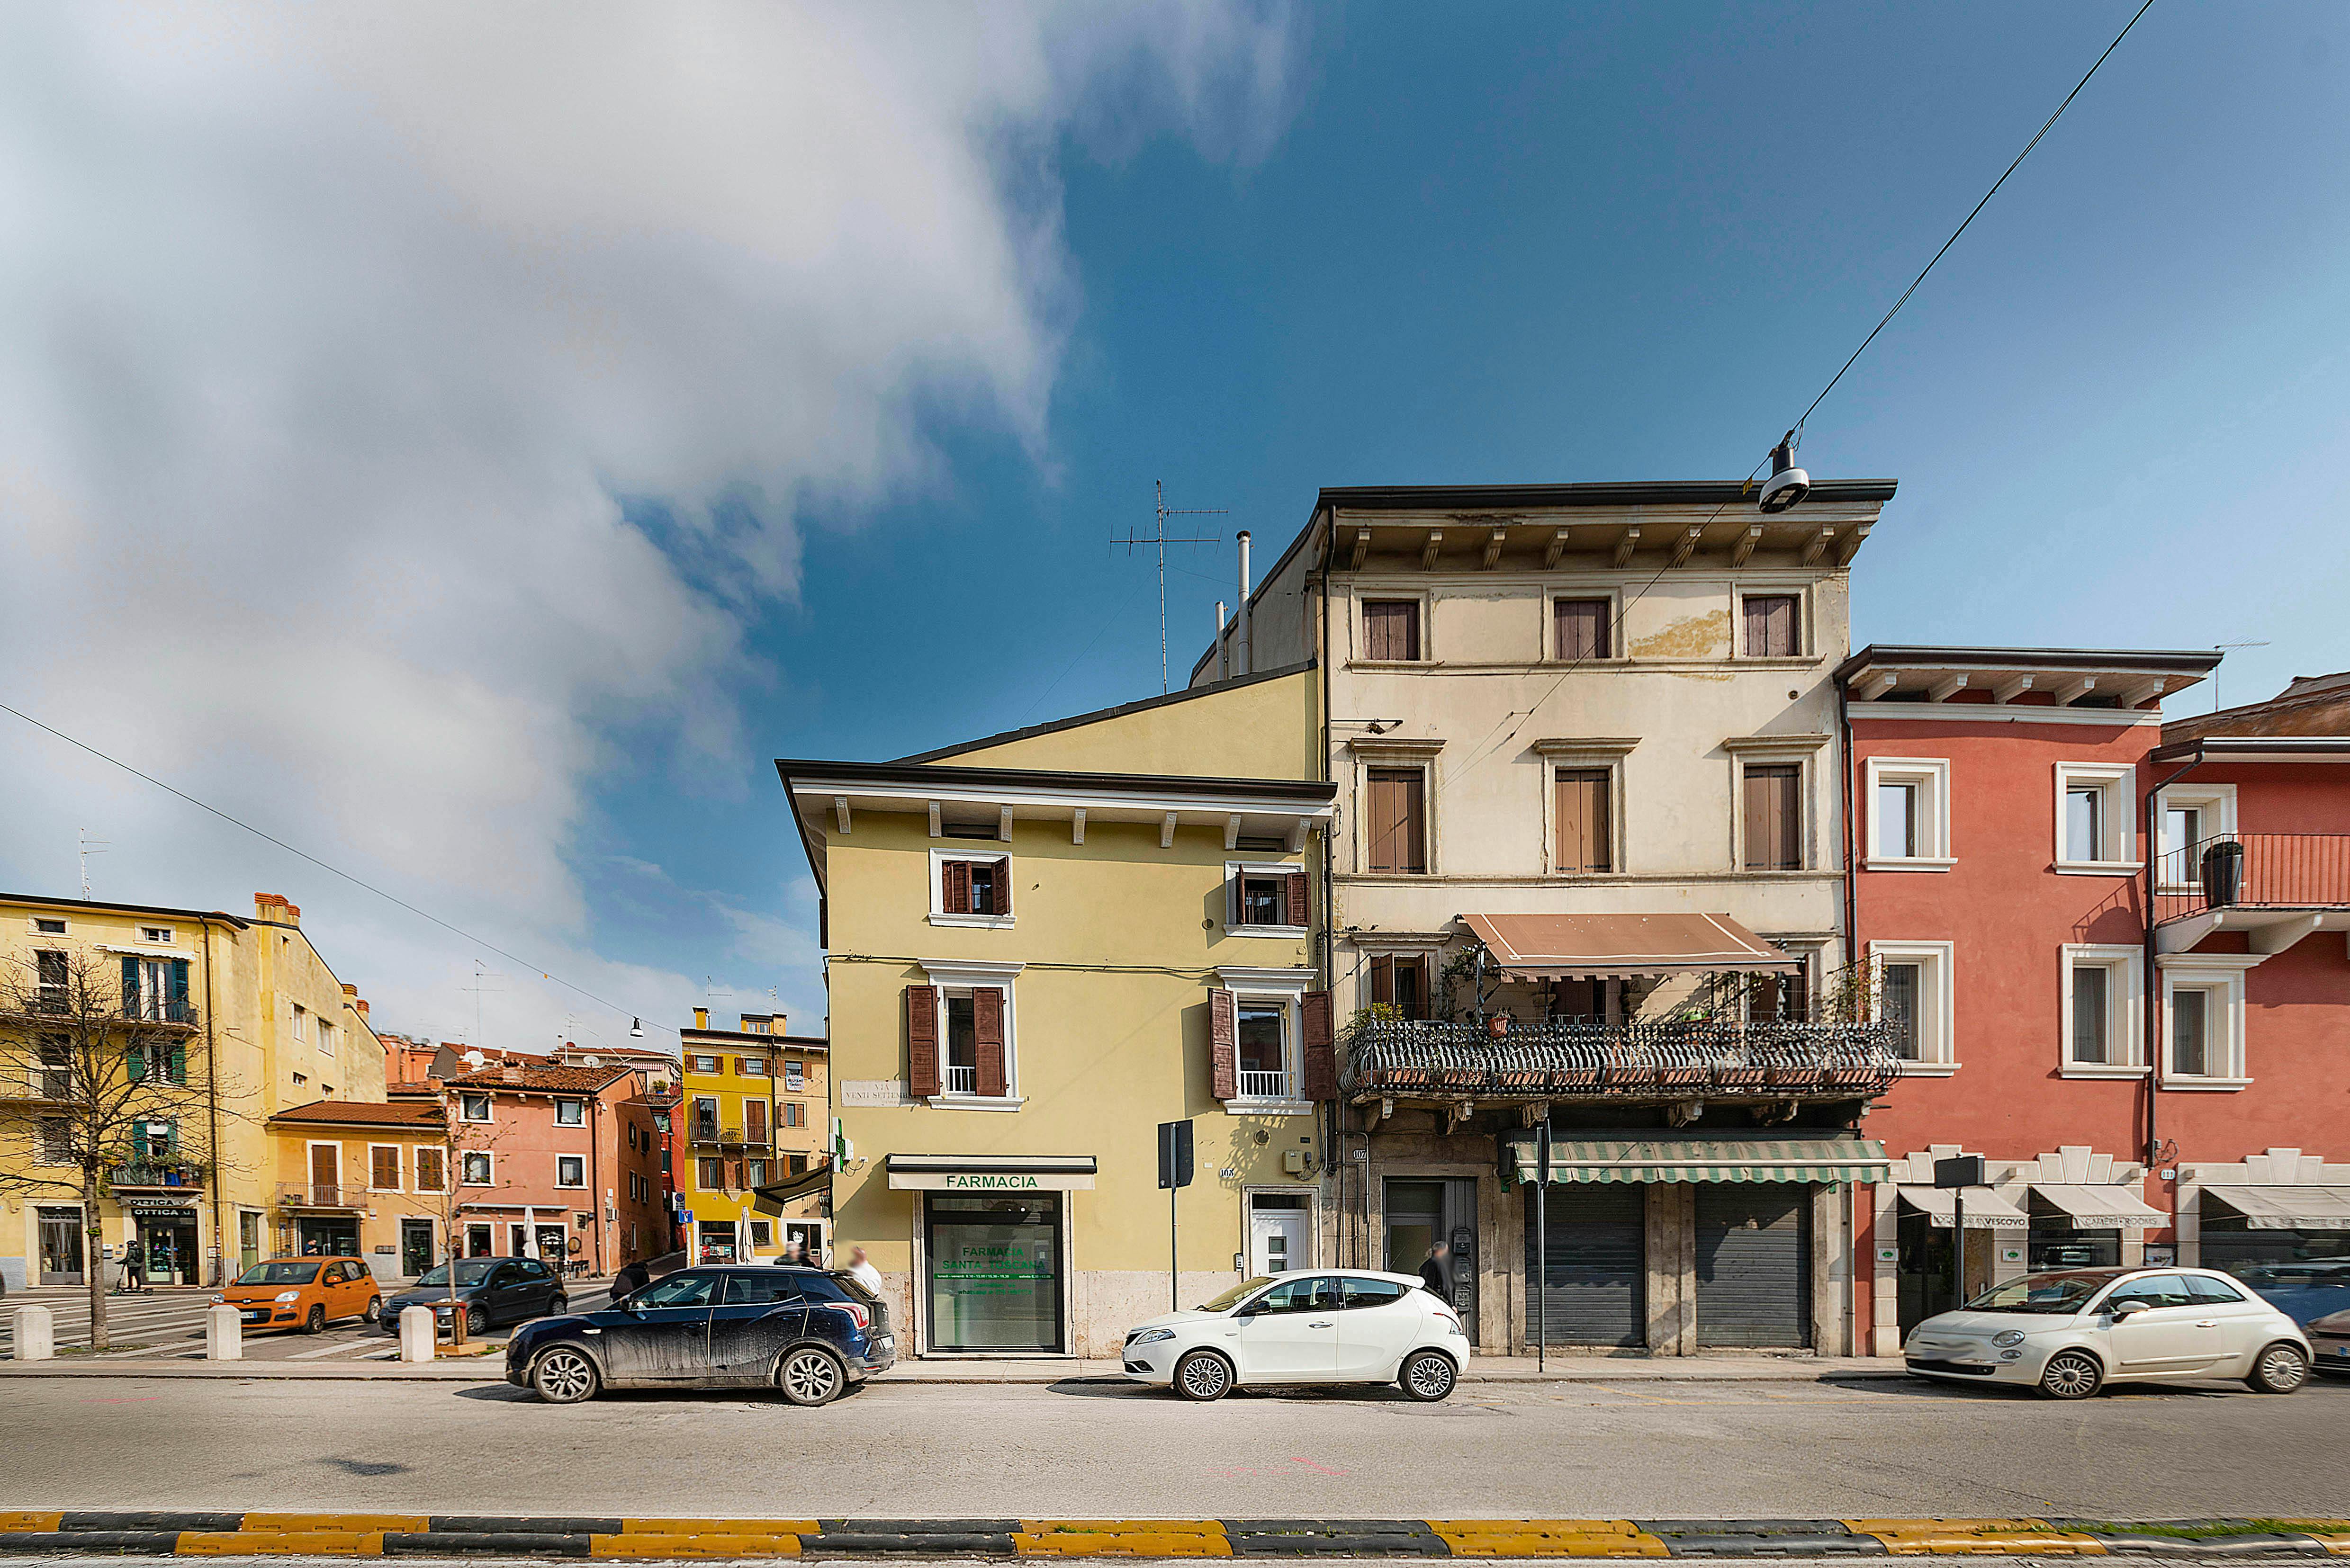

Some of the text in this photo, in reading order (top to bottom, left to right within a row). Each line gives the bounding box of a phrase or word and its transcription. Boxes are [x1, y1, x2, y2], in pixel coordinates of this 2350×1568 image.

[946, 1175, 1038, 1188] FARMACIA
[963, 1247, 1024, 1256] FARMACIA
[943, 1260, 1045, 1270] SANTA TOSCANA
